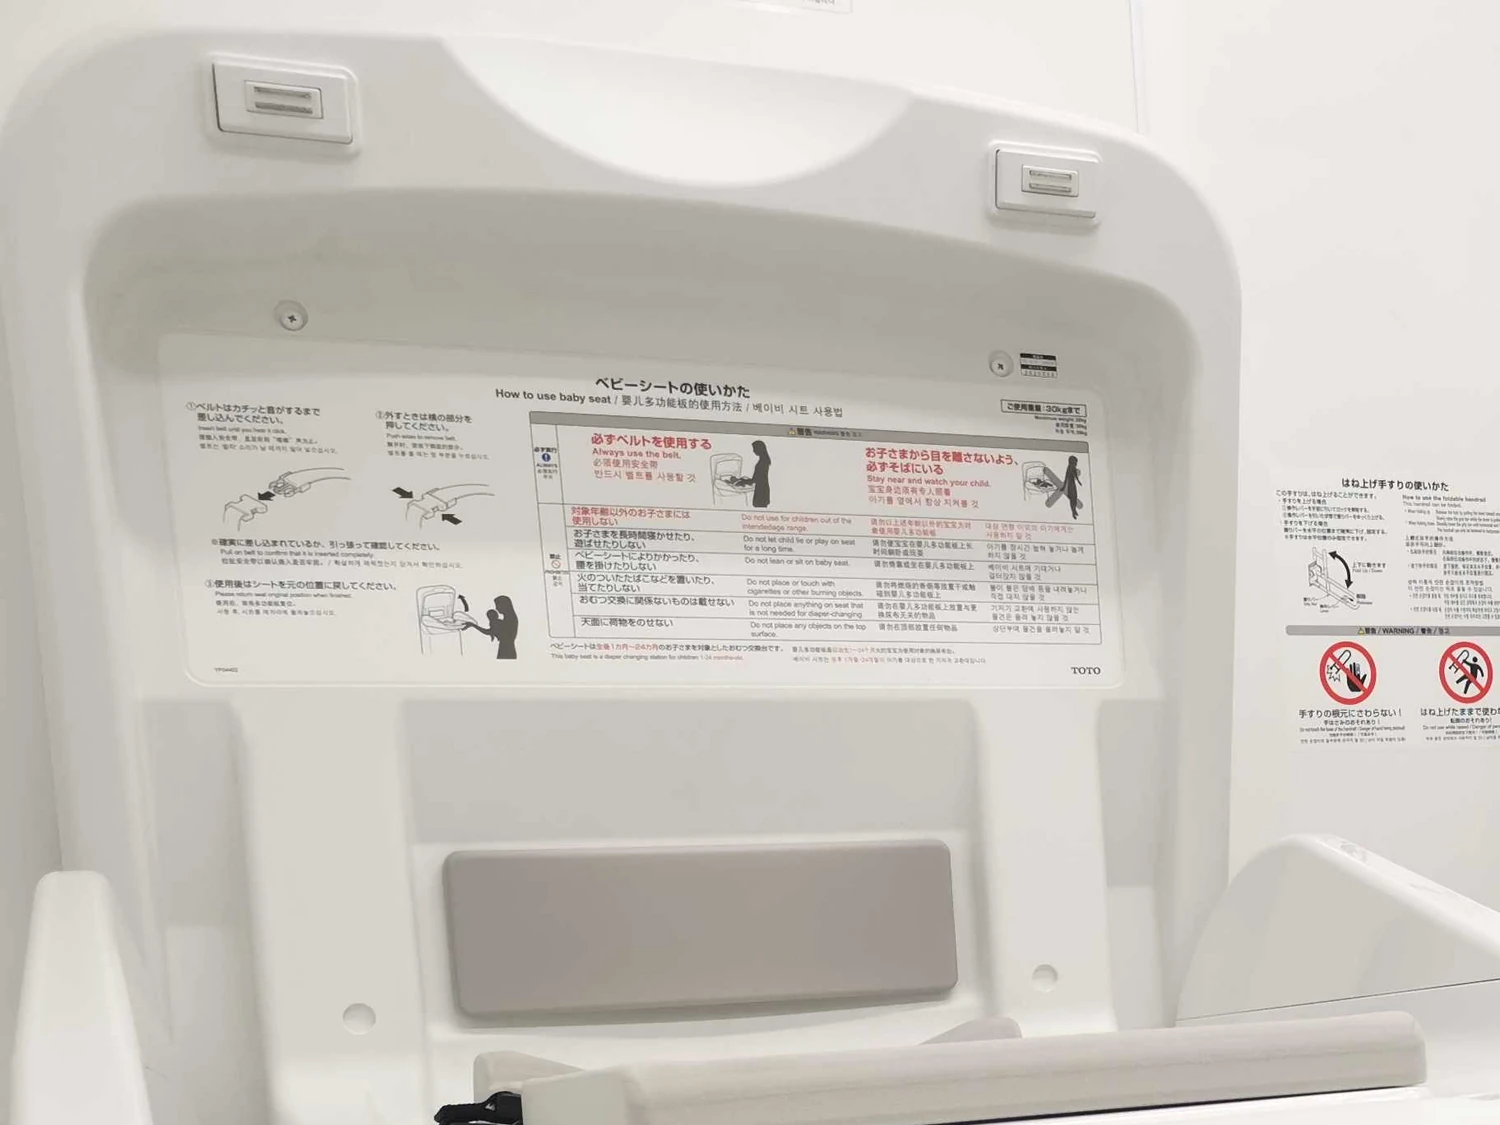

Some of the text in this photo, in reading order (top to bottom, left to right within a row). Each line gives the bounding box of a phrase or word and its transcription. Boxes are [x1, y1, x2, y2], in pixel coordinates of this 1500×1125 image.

[596, 378, 750, 398] ベビーシートの使いかた
[496, 389, 520, 399] How
[523, 391, 533, 400] to
[560, 392, 585, 404] baby
[589, 395, 611, 404] seat
[622, 395, 742, 412] 婴儿多功能板的使用方法
[752, 403, 784, 414] 베이비
[789, 405, 809, 415] 시트
[813, 407, 843, 418] 사용법
[591, 433, 712, 450] 必ずベルトを使用する
[592, 449, 624, 459] Always
[662, 451, 681, 459] belt.
[866, 463, 944, 475] 必ずそばにいる
[867, 475, 884, 485] Stay
[910, 476, 922, 484] and
[925, 477, 948, 486] watch
[950, 479, 968, 488] your
[970, 478, 991, 487] child.
[1342, 478, 1449, 492] はね上げ手すりの使いかた
[572, 517, 618, 526] 使用しない
[578, 583, 640, 593] 当てたりしない
[1071, 667, 1100, 675] TOTO
